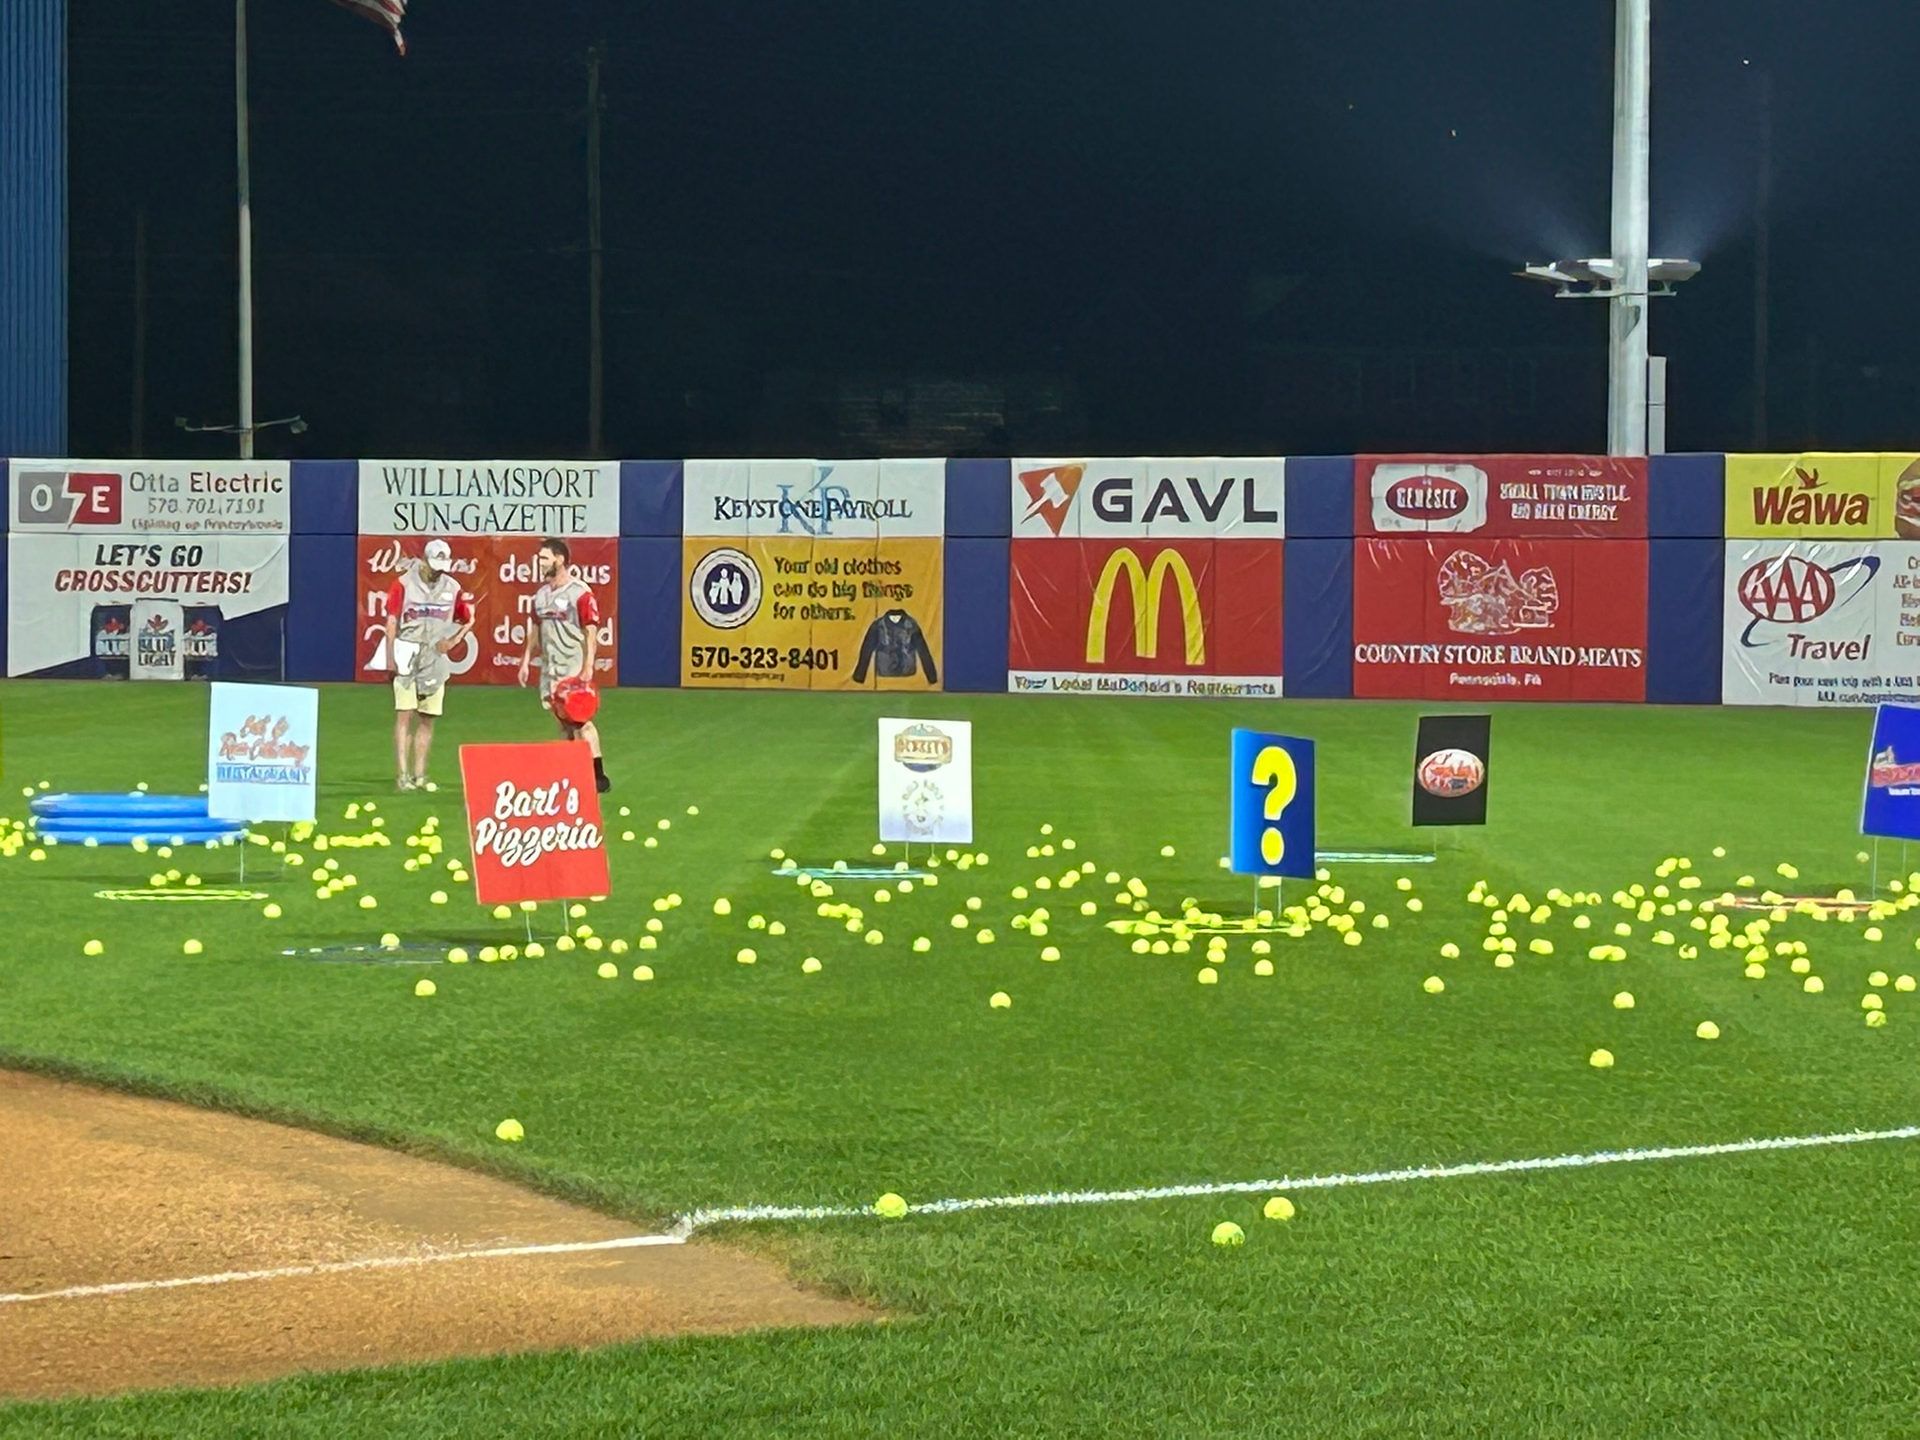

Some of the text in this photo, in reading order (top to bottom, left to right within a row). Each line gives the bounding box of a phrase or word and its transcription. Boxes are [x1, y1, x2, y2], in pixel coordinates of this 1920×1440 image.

[130, 471, 283, 494] Otta Electric
[382, 466, 600, 498] WILLIAMSPORT
[30, 484, 110, 513] O E
[1092, 477, 1278, 523] GAVL
[1753, 486, 1870, 525] Wawa
[393, 502, 588, 533] SUN-GAZETTE
[95, 544, 203, 567] LET'S GO
[500, 554, 611, 584] delous
[774, 557, 810, 573] Your
[55, 570, 251, 593] CROSSCUTTERS!
[1746, 557, 1826, 620] AAA
[691, 646, 839, 670] 570-323-8401
[1355, 644, 1642, 668] COUNTRY STORE BRAND MEATS
[1787, 633, 1871, 660] Travel
[495, 778, 579, 820] Bart's
[1251, 745, 1297, 866] ?
[475, 817, 603, 867] Pizzeria
